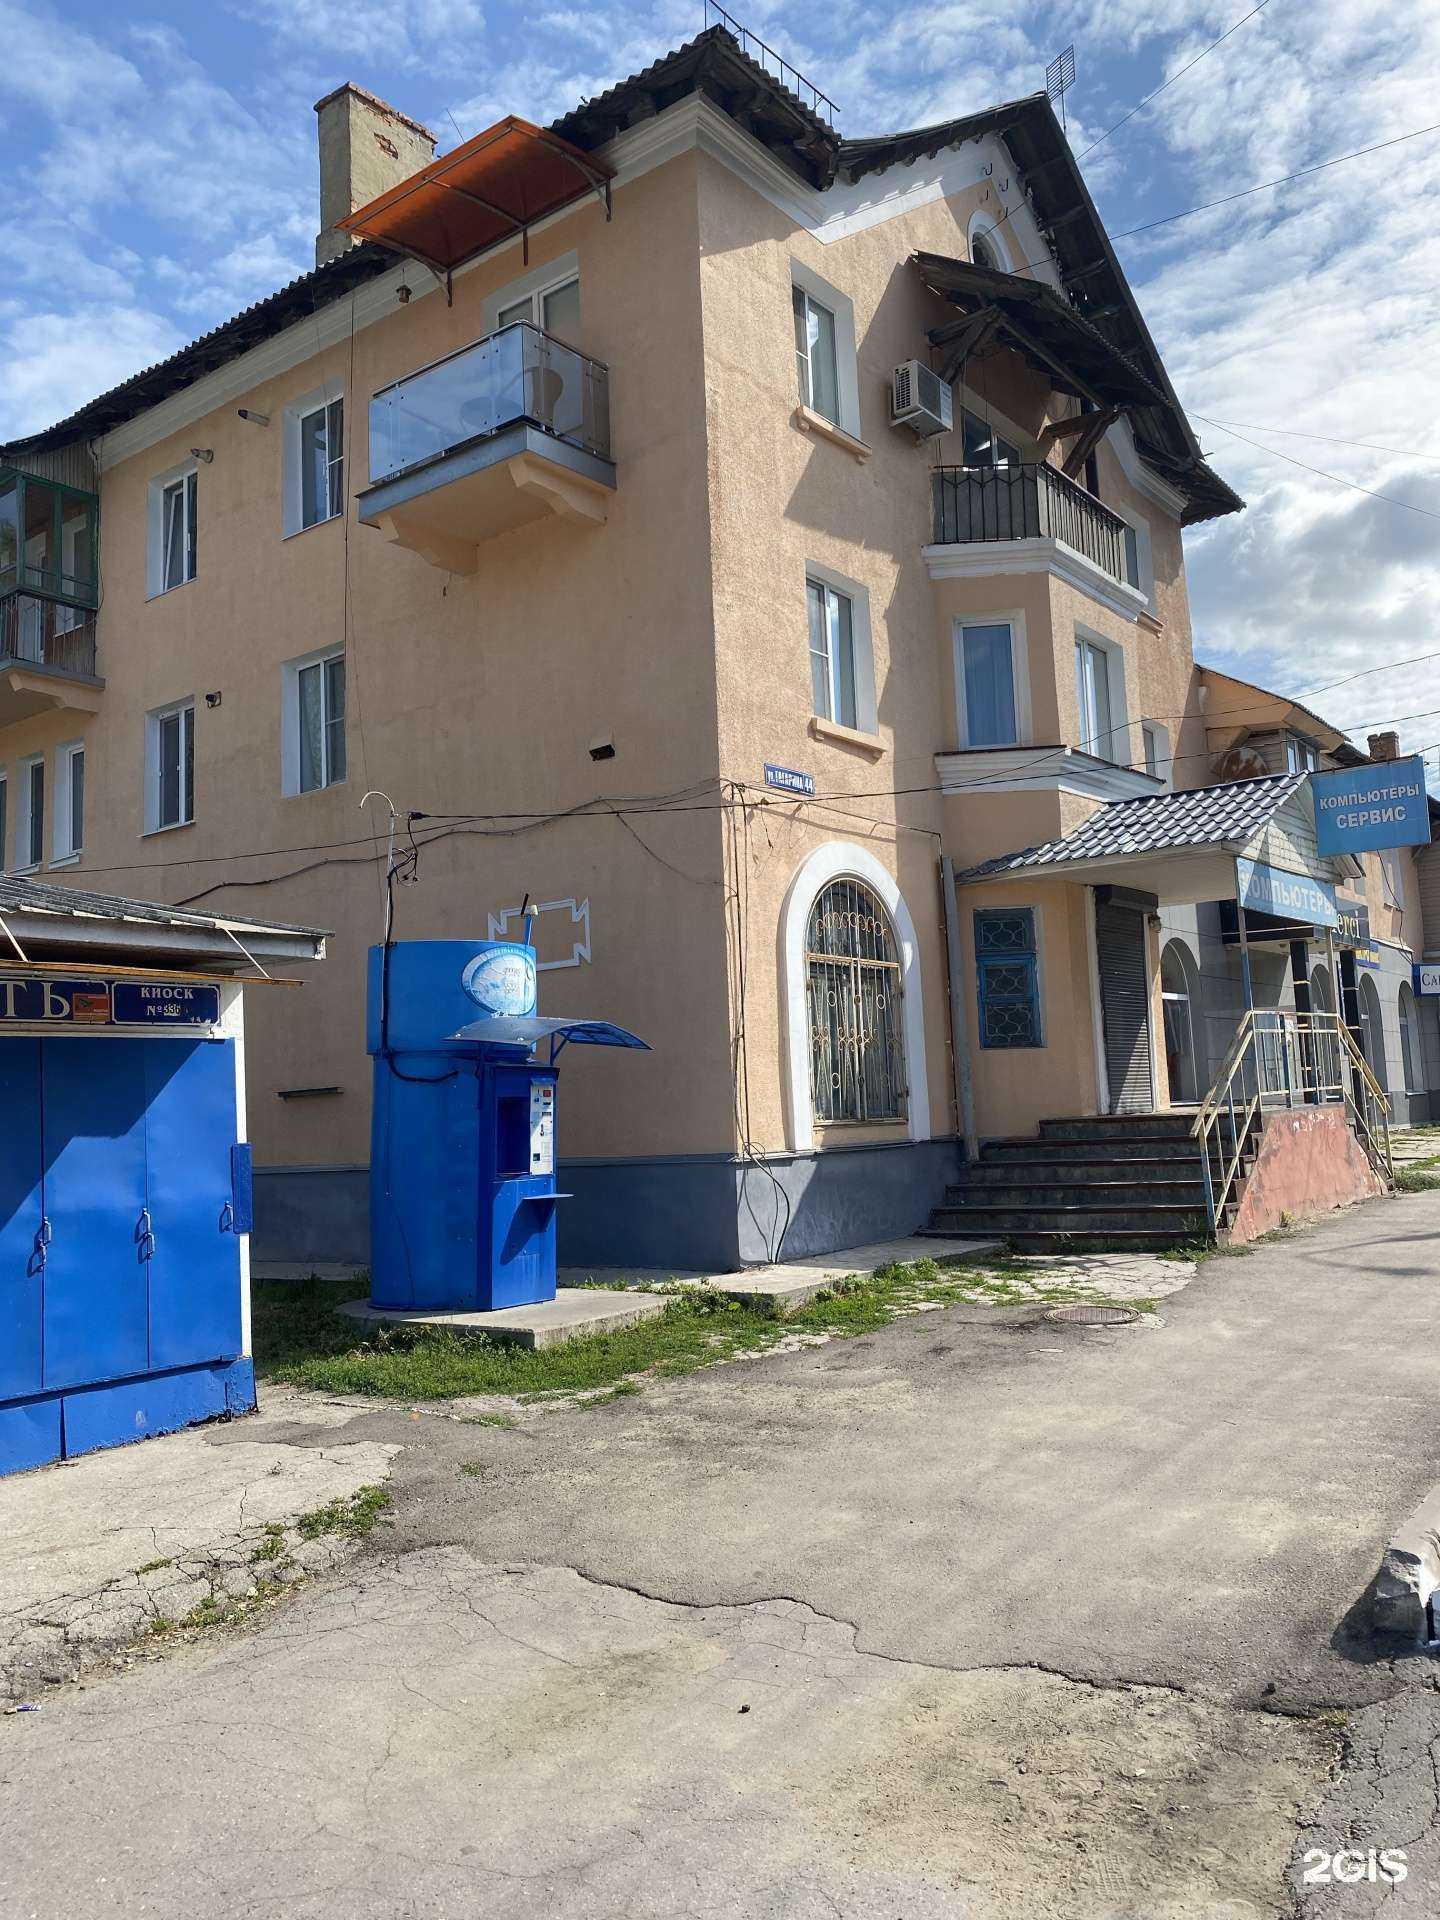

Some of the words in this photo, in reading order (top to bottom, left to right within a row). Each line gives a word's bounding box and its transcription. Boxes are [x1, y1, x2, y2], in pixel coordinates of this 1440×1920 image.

[1319, 783, 1420, 810] КОМПЬЮТЕРЫ
[1336, 806, 1406, 829] СЕРВИС
[1332, 910, 1360, 938] erci
[141, 986, 194, 999] КИОСК
